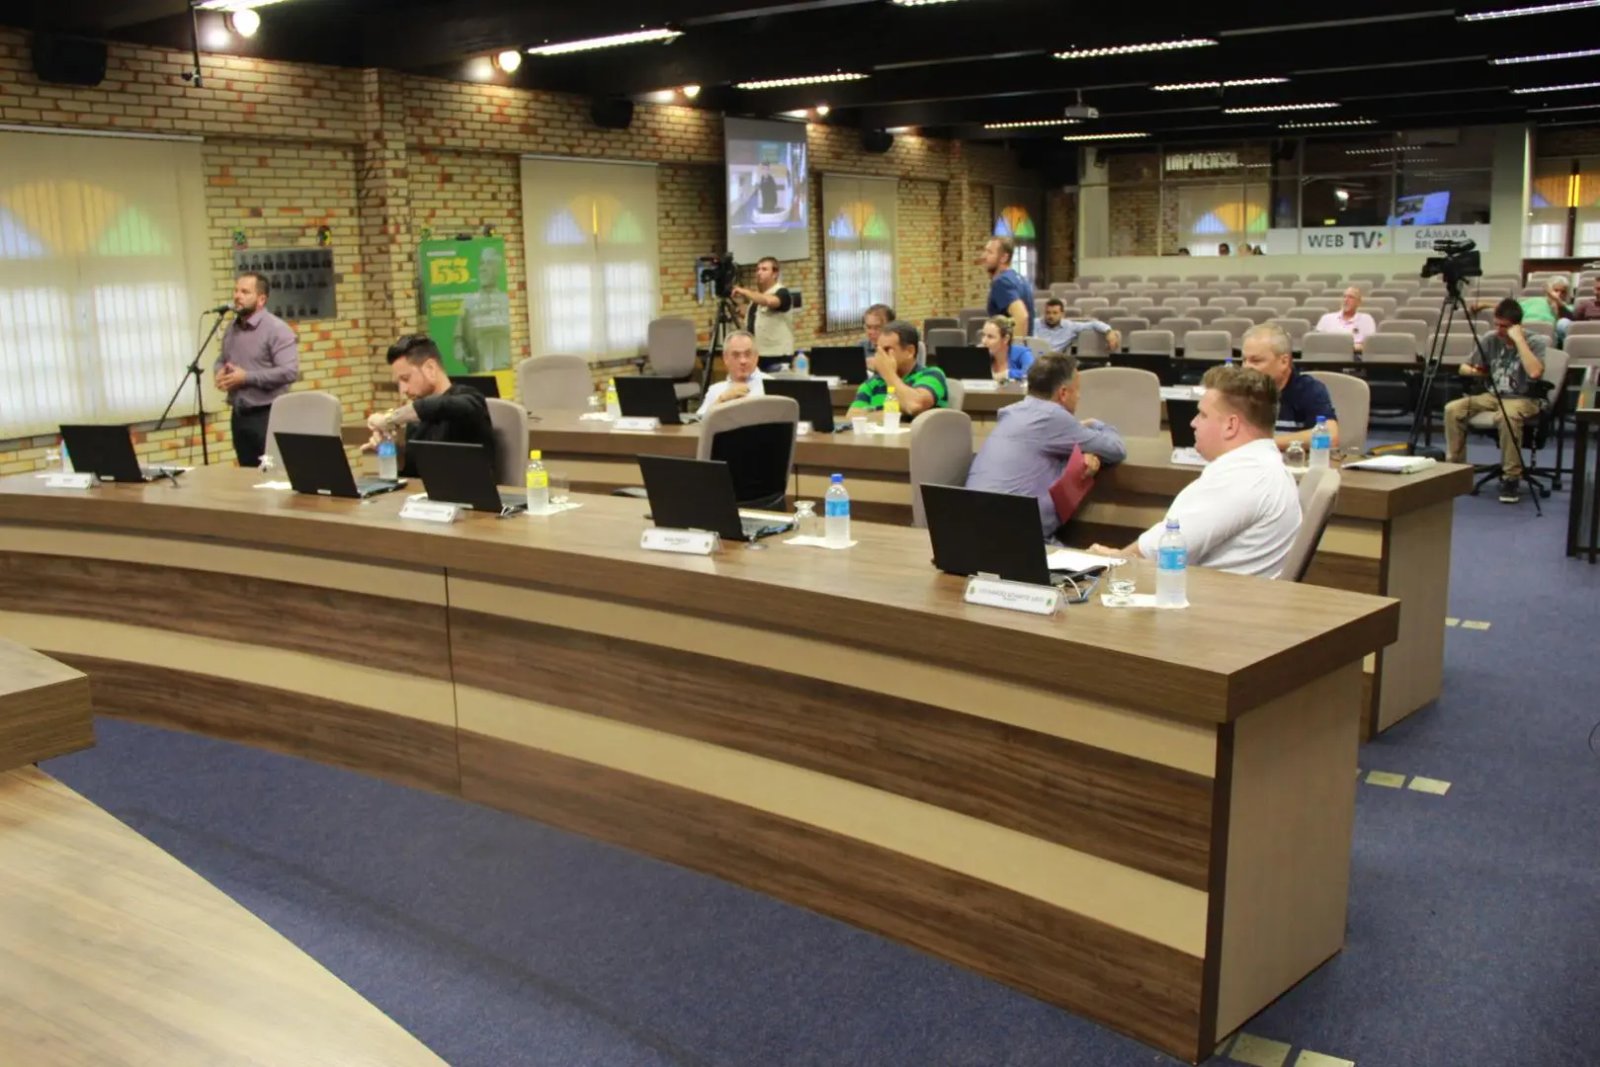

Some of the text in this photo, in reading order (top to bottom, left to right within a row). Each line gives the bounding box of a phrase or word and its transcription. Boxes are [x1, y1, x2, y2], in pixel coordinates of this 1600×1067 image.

[1308, 230, 1377, 249] WEB TV
[1415, 227, 1467, 238] CÂMARA
